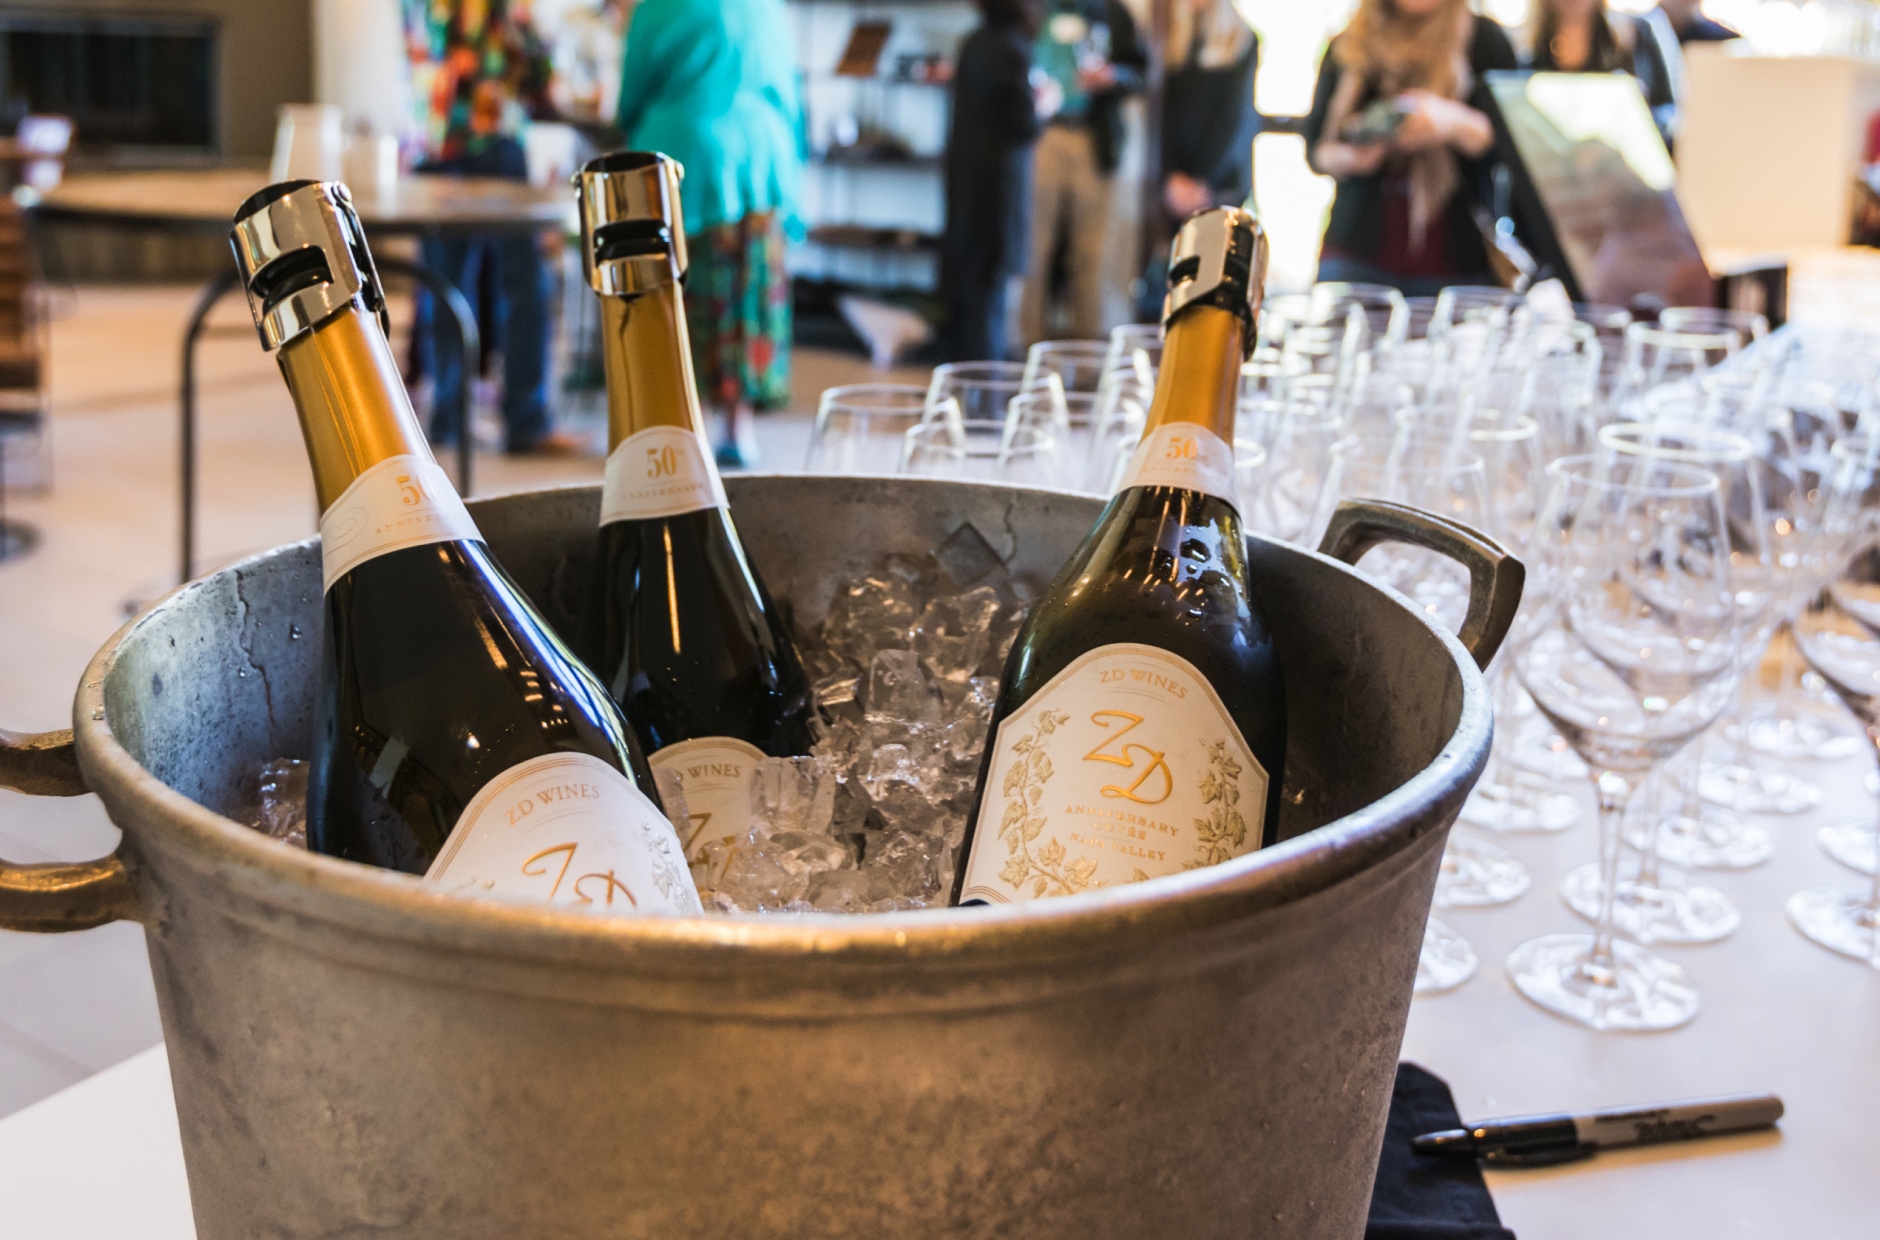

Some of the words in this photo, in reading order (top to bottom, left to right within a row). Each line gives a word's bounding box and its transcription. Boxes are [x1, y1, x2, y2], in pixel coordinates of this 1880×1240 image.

[1099, 669, 1125, 683] ZD
[1130, 669, 1187, 698] WINES
[688, 763, 741, 779] WINES
[1082, 710, 1173, 805] ZD
[504, 799, 533, 826] ZD
[536, 783, 600, 804] WINES
[1065, 805, 1178, 837] ANNIVERSARY
[1069, 832, 1105, 849] NAPA
[1112, 841, 1165, 861] VALLEY
